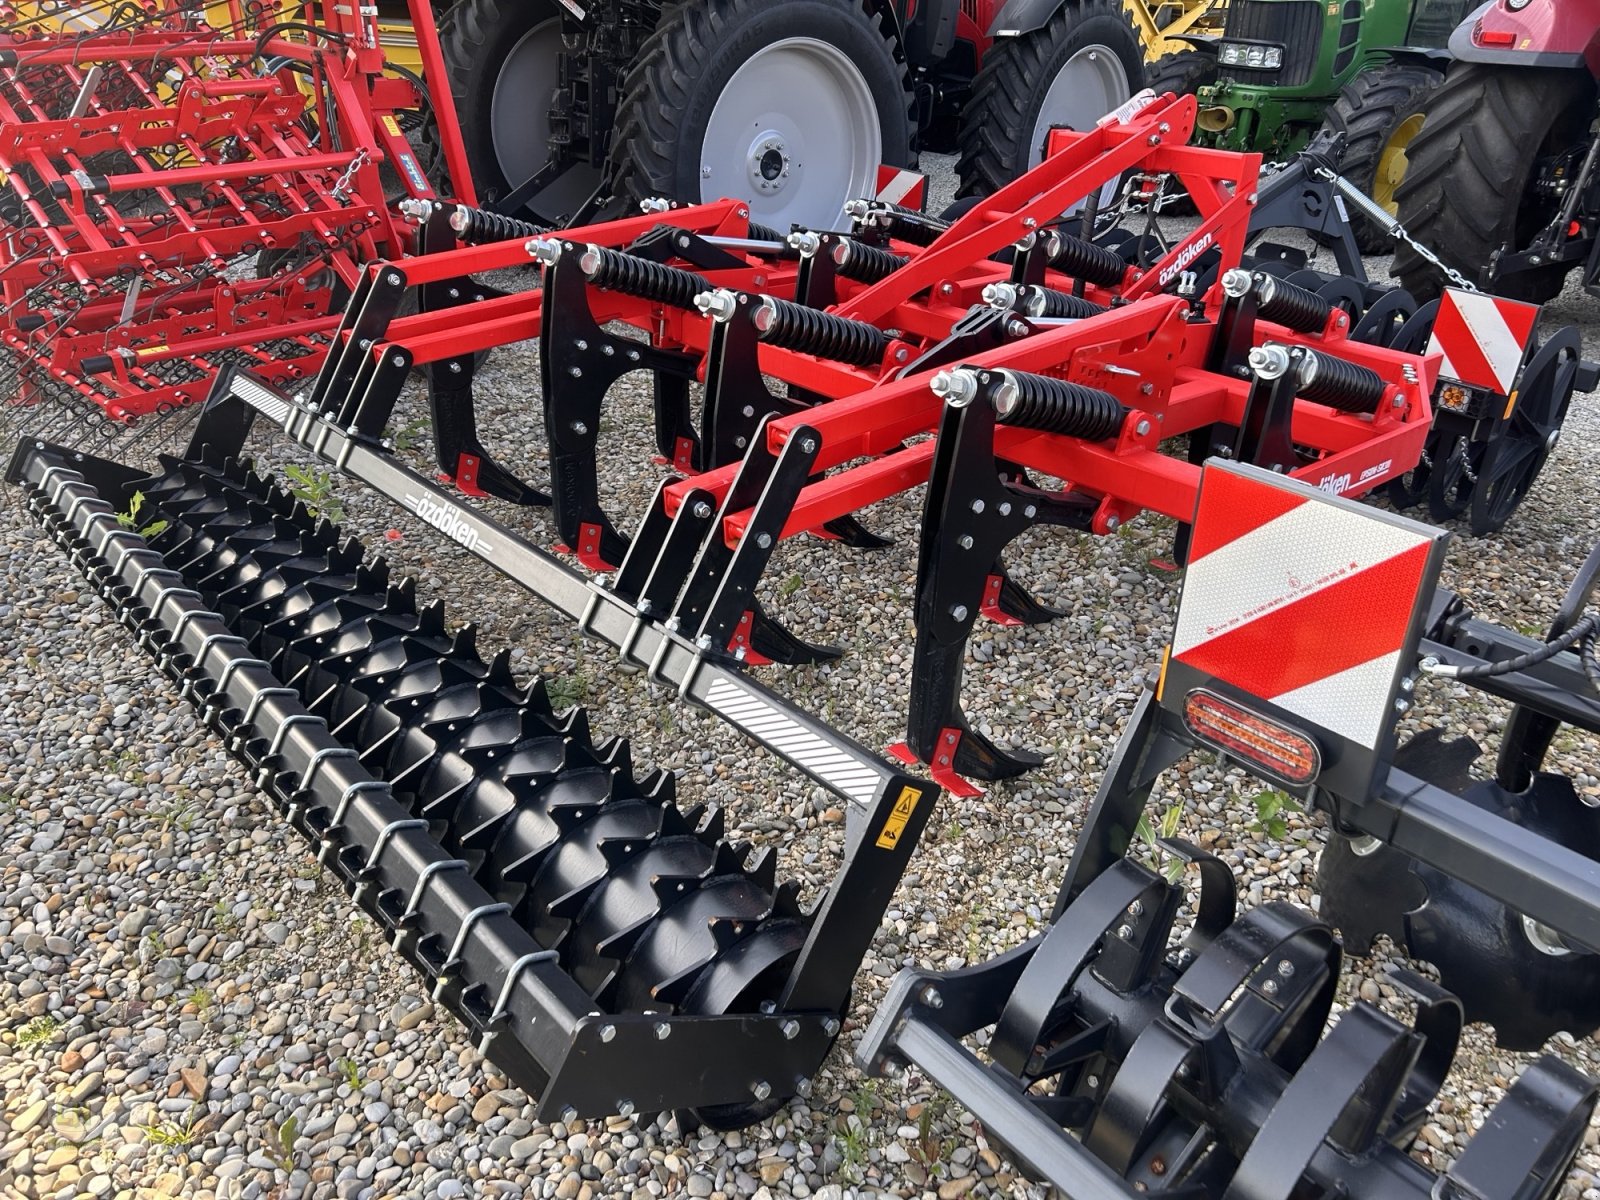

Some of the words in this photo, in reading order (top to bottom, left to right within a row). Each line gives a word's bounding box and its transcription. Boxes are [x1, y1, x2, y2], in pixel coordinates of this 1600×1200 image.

[1159, 232, 1212, 286] özdöken
[1319, 472, 1351, 497] öken
[416, 491, 479, 551] özdöken
